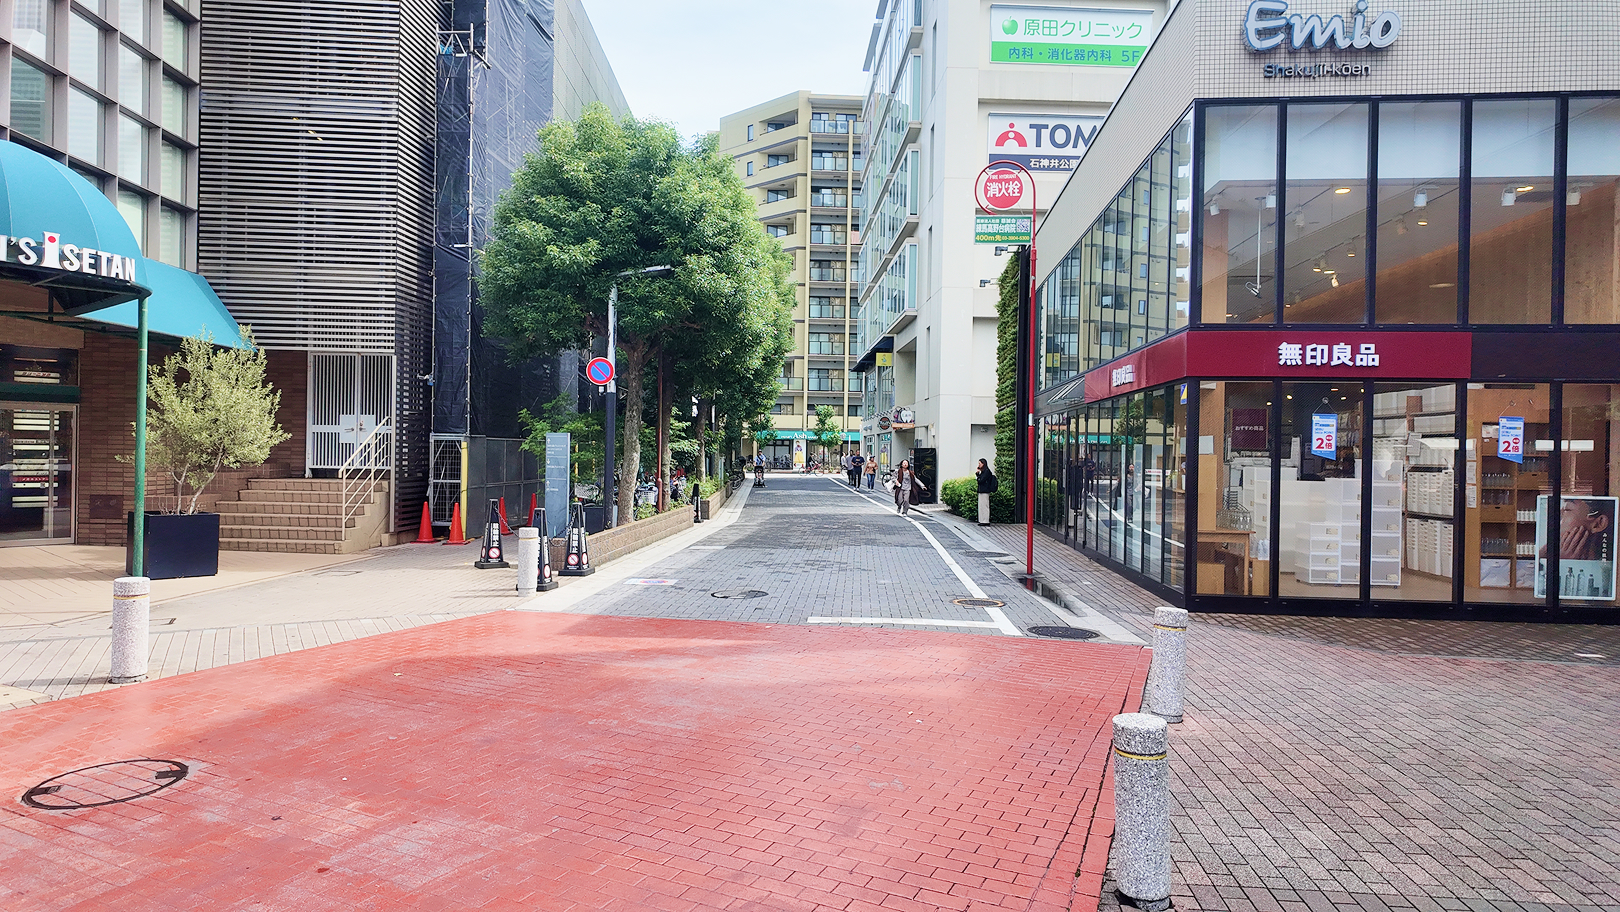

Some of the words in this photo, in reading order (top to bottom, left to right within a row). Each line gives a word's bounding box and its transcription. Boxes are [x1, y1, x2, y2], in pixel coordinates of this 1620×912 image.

[1023, 18, 1143, 39] 原田クリニック
[1244, 0, 1402, 51] Emio
[1008, 46, 1112, 62] 内科・消化器内科
[1121, 50, 1140, 62] 5F
[1029, 123, 1097, 149] TOM
[986, 180, 1021, 198] 消火栓
[1278, 341, 1380, 368] 無印良品
[1112, 364, 1134, 387] 無印良品
